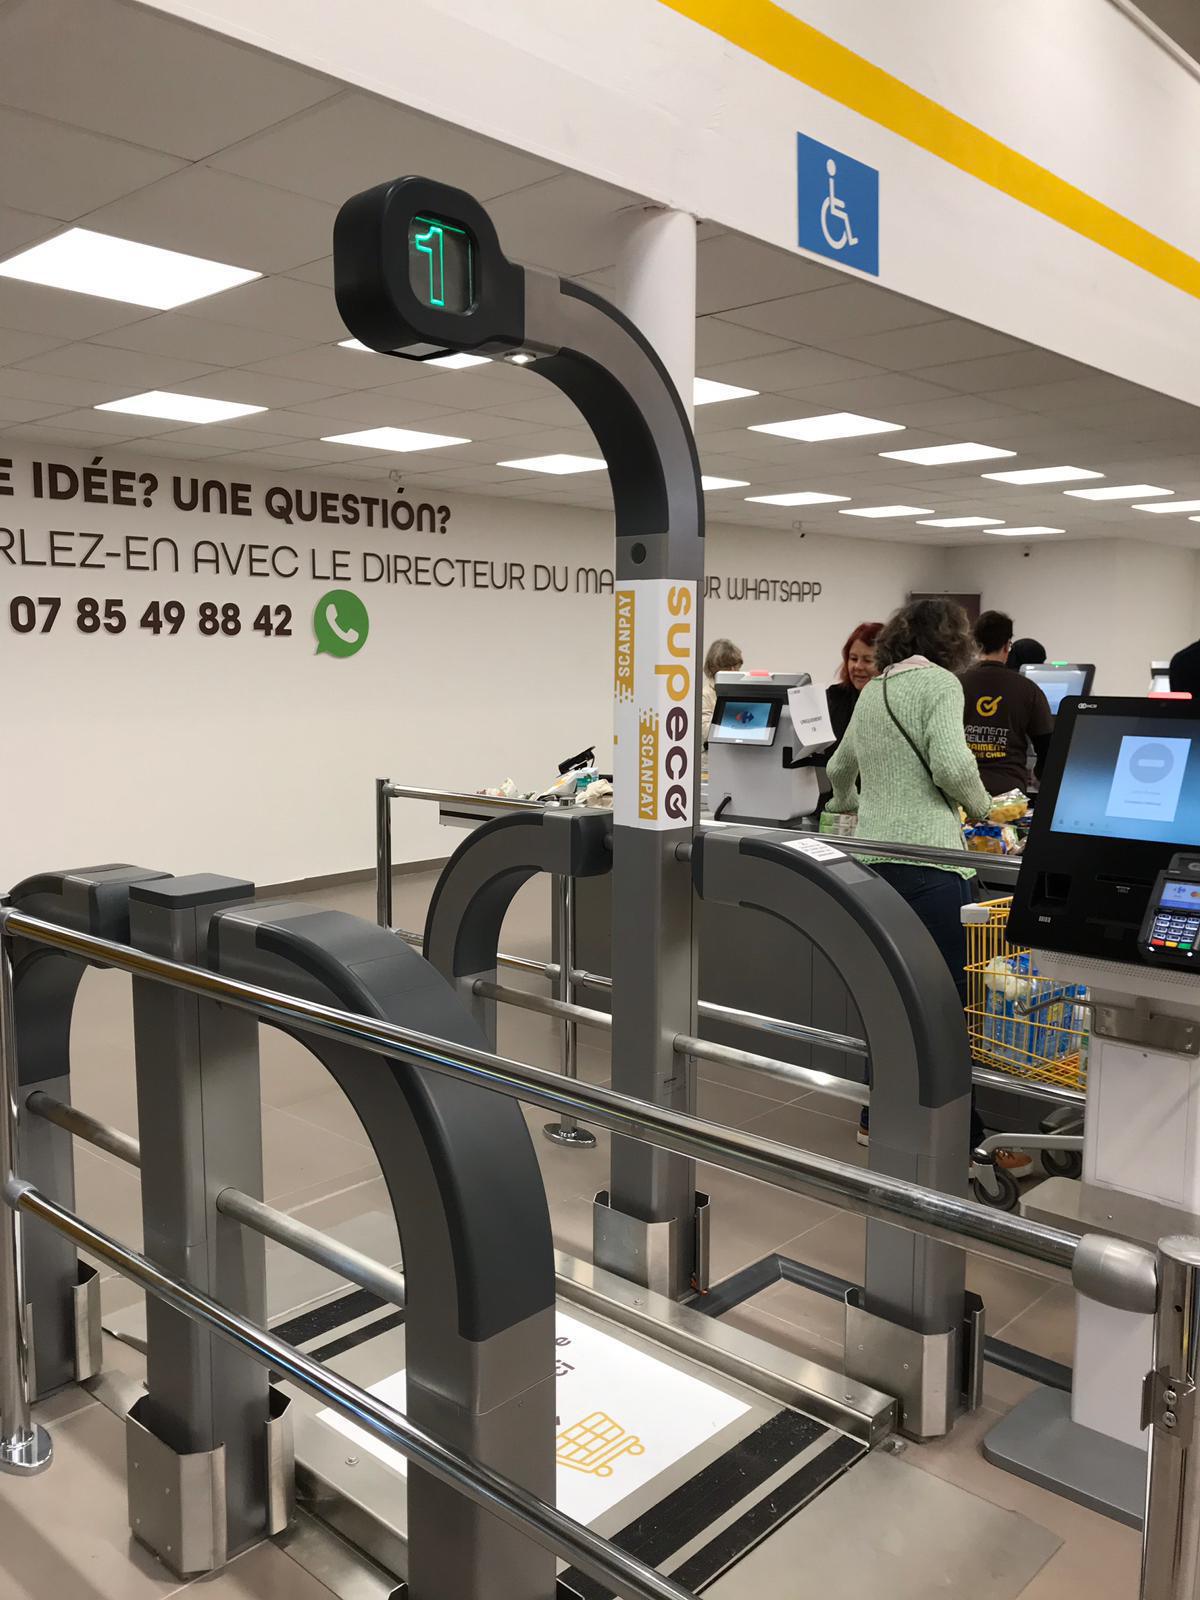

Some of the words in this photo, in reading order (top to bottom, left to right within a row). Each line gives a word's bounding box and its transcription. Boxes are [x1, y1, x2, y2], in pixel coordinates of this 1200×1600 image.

[414, 226, 445, 307] 1
[32, 456, 159, 507] IDÉE?
[173, 476, 252, 517] UNE
[265, 487, 451, 535] QUESTION?
[193, 540, 299, 580] AVEC
[312, 548, 351, 582] LE
[363, 551, 525, 591] DIRECTEUR
[534, 564, 568, 593] DU
[576, 567, 615, 595] MA
[728, 577, 821, 603] WHATSAPP
[9, 596, 61, 636] 07
[76, 597, 126, 636] 85
[140, 601, 185, 637] 49
[199, 602, 241, 638] 88
[252, 604, 293, 638] 42
[617, 594, 632, 677] SCANPAY
[641, 733, 655, 817] SCANPAY
